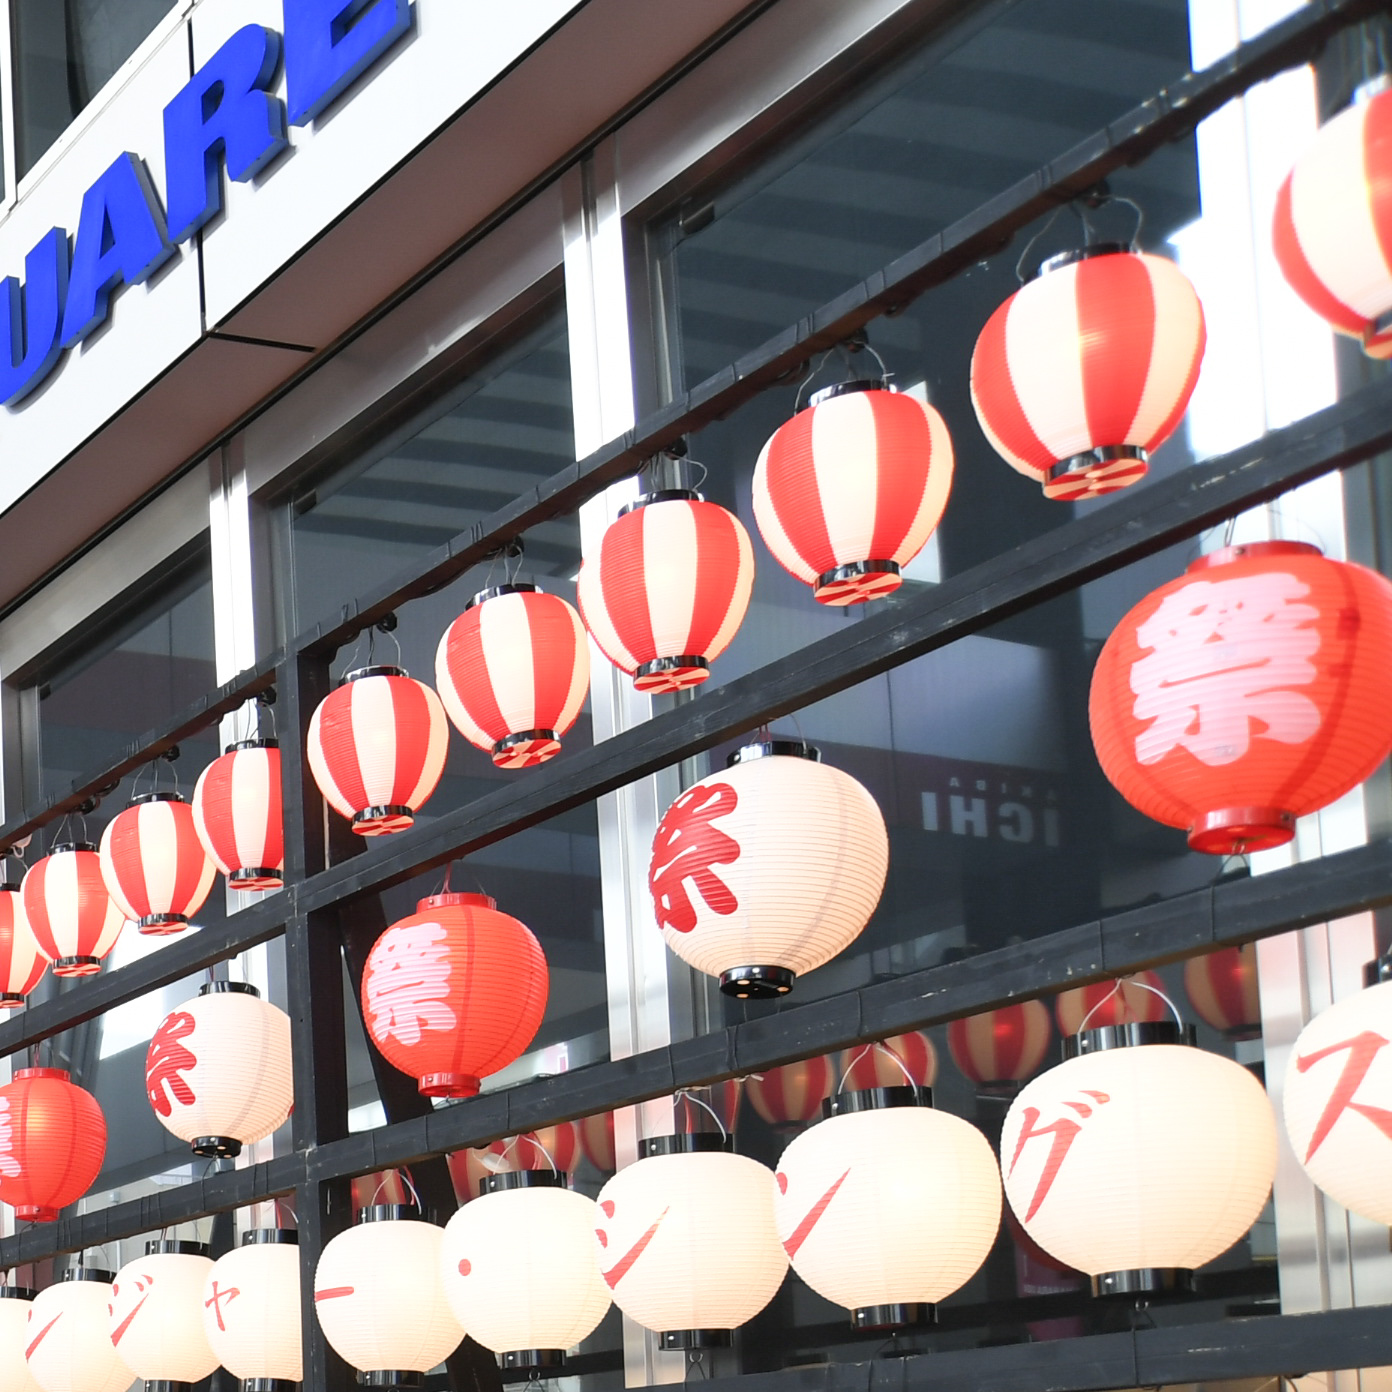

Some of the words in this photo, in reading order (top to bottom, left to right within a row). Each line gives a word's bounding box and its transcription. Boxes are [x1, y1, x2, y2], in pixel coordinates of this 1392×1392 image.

[1130, 572, 1322, 767] 祭
[649, 783, 742, 934] 祭
[367, 922, 458, 1047] 祭
